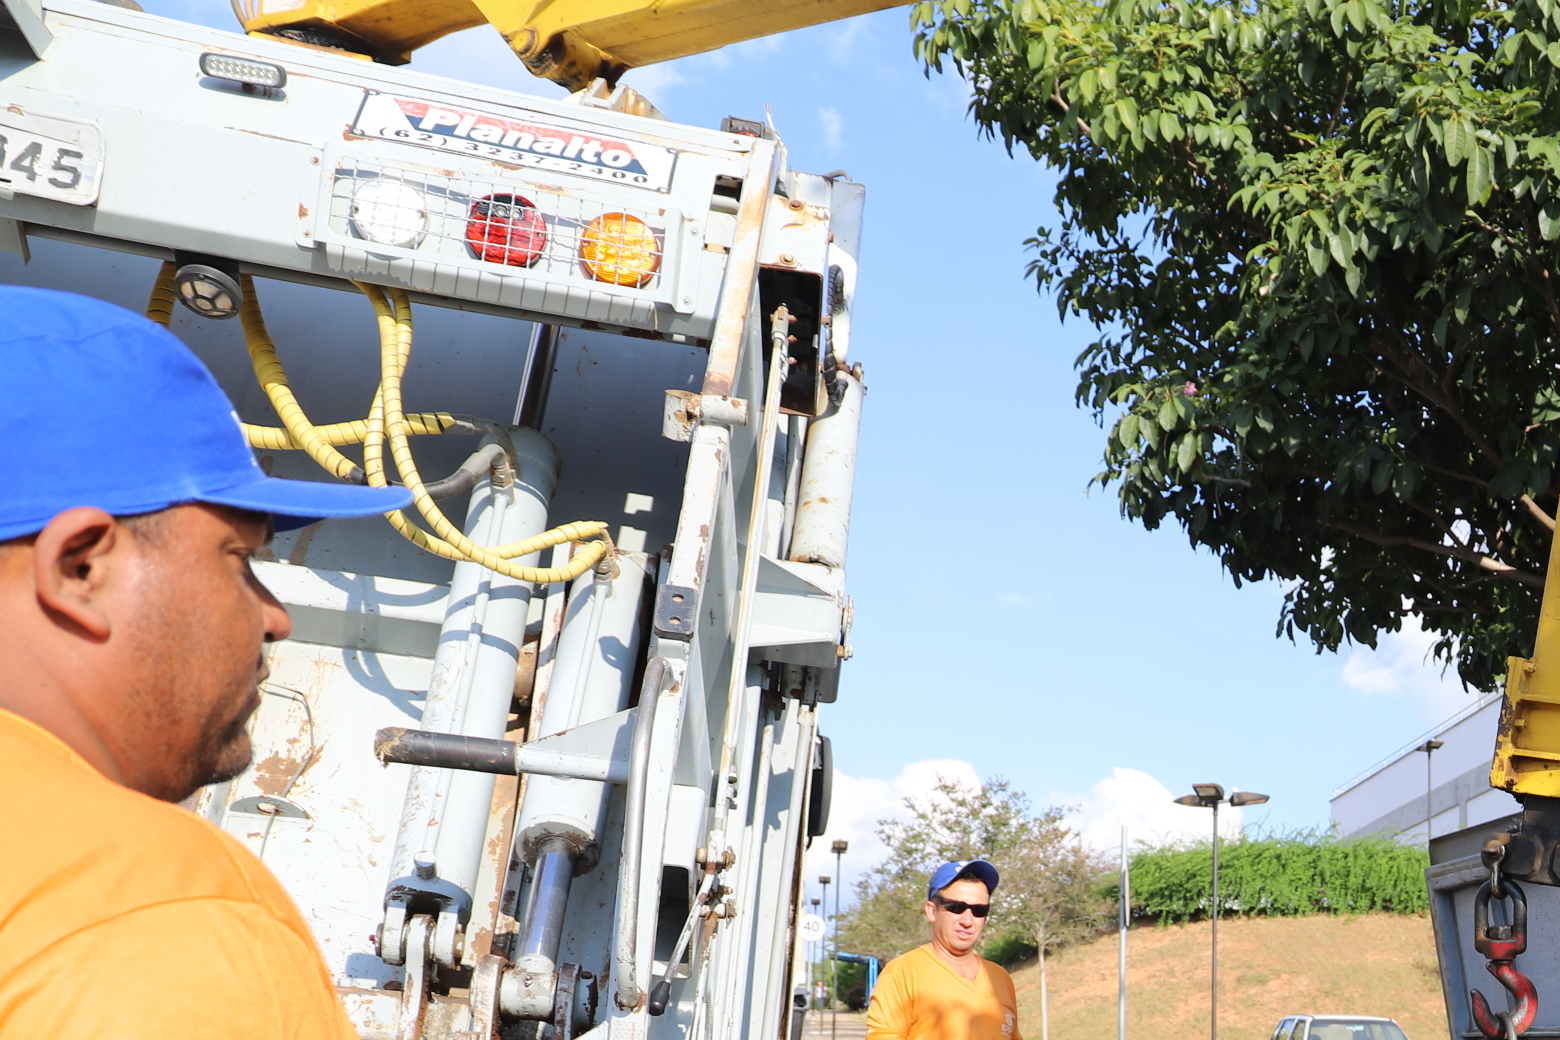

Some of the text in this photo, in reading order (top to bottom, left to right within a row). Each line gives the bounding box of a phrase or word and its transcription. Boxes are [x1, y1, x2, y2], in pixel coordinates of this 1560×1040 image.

[0, 133, 84, 189] 45
[379, 126, 649, 184] (62) 3237-2400
[417, 106, 633, 168] Planalto
[803, 921, 819, 932] 40
